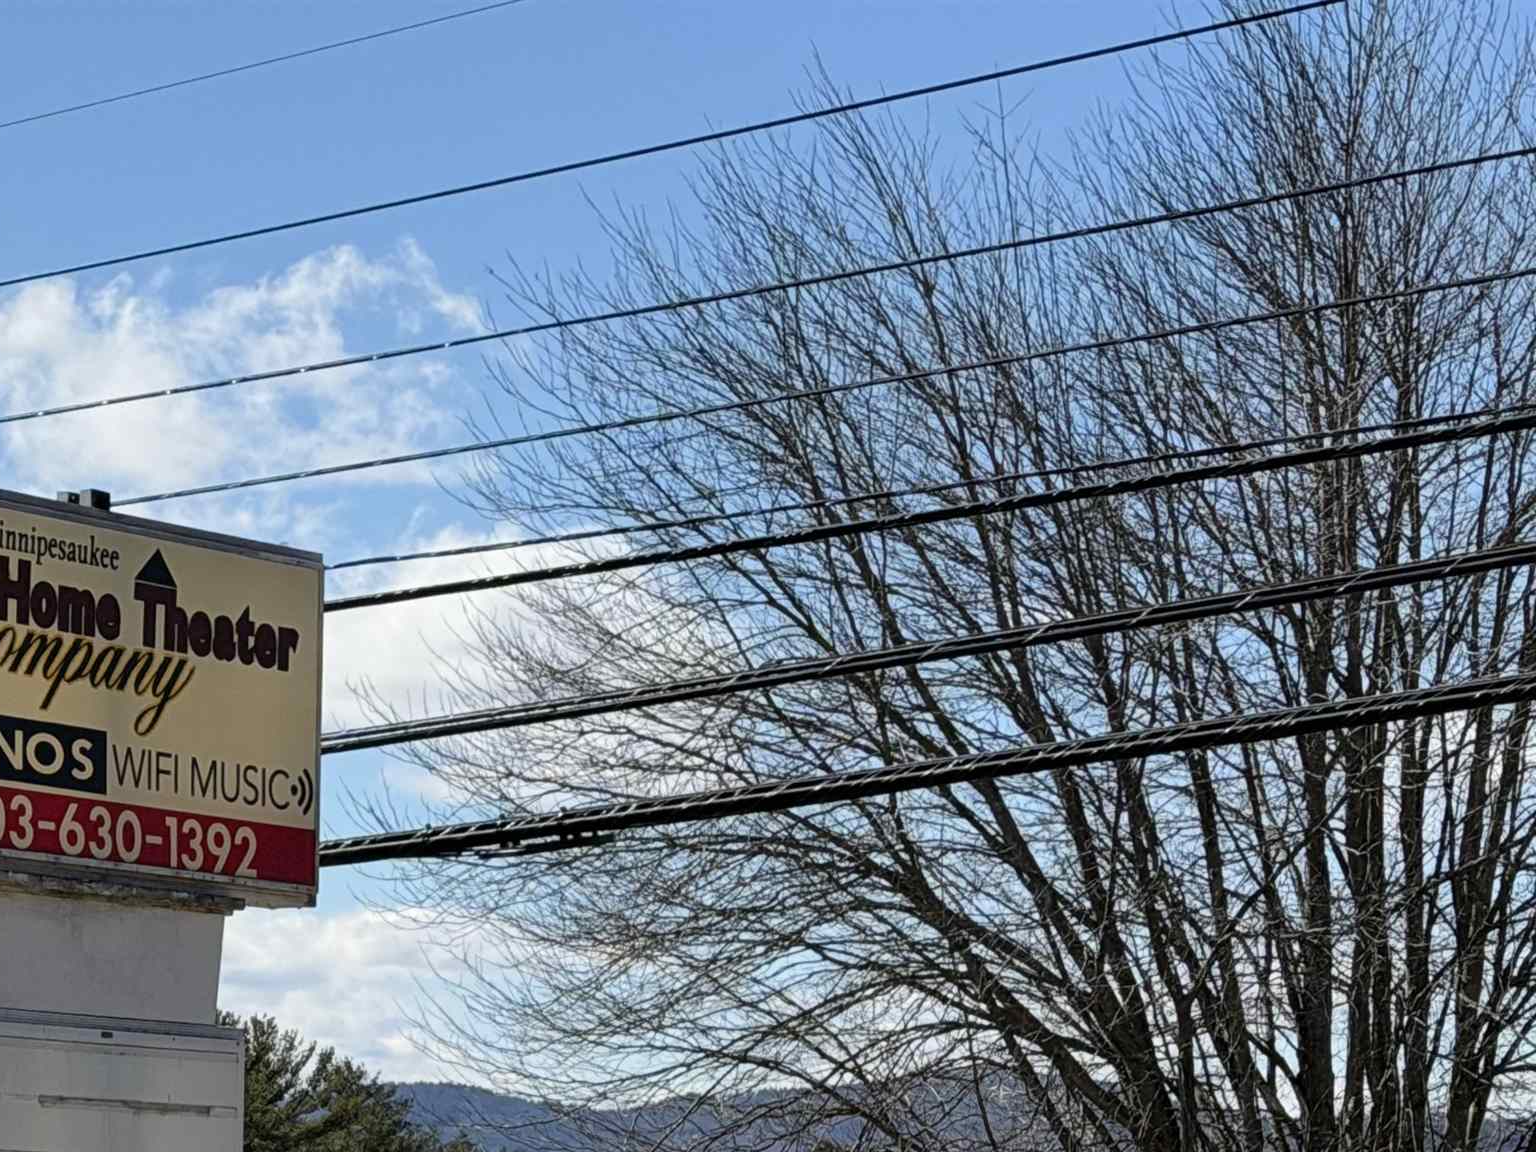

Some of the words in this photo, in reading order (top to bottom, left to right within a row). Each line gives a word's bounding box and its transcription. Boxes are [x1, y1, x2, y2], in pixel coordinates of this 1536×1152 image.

[134, 582, 299, 672] Theater
[112, 744, 179, 794] WIFI
[192, 757, 289, 811] MUSIC
